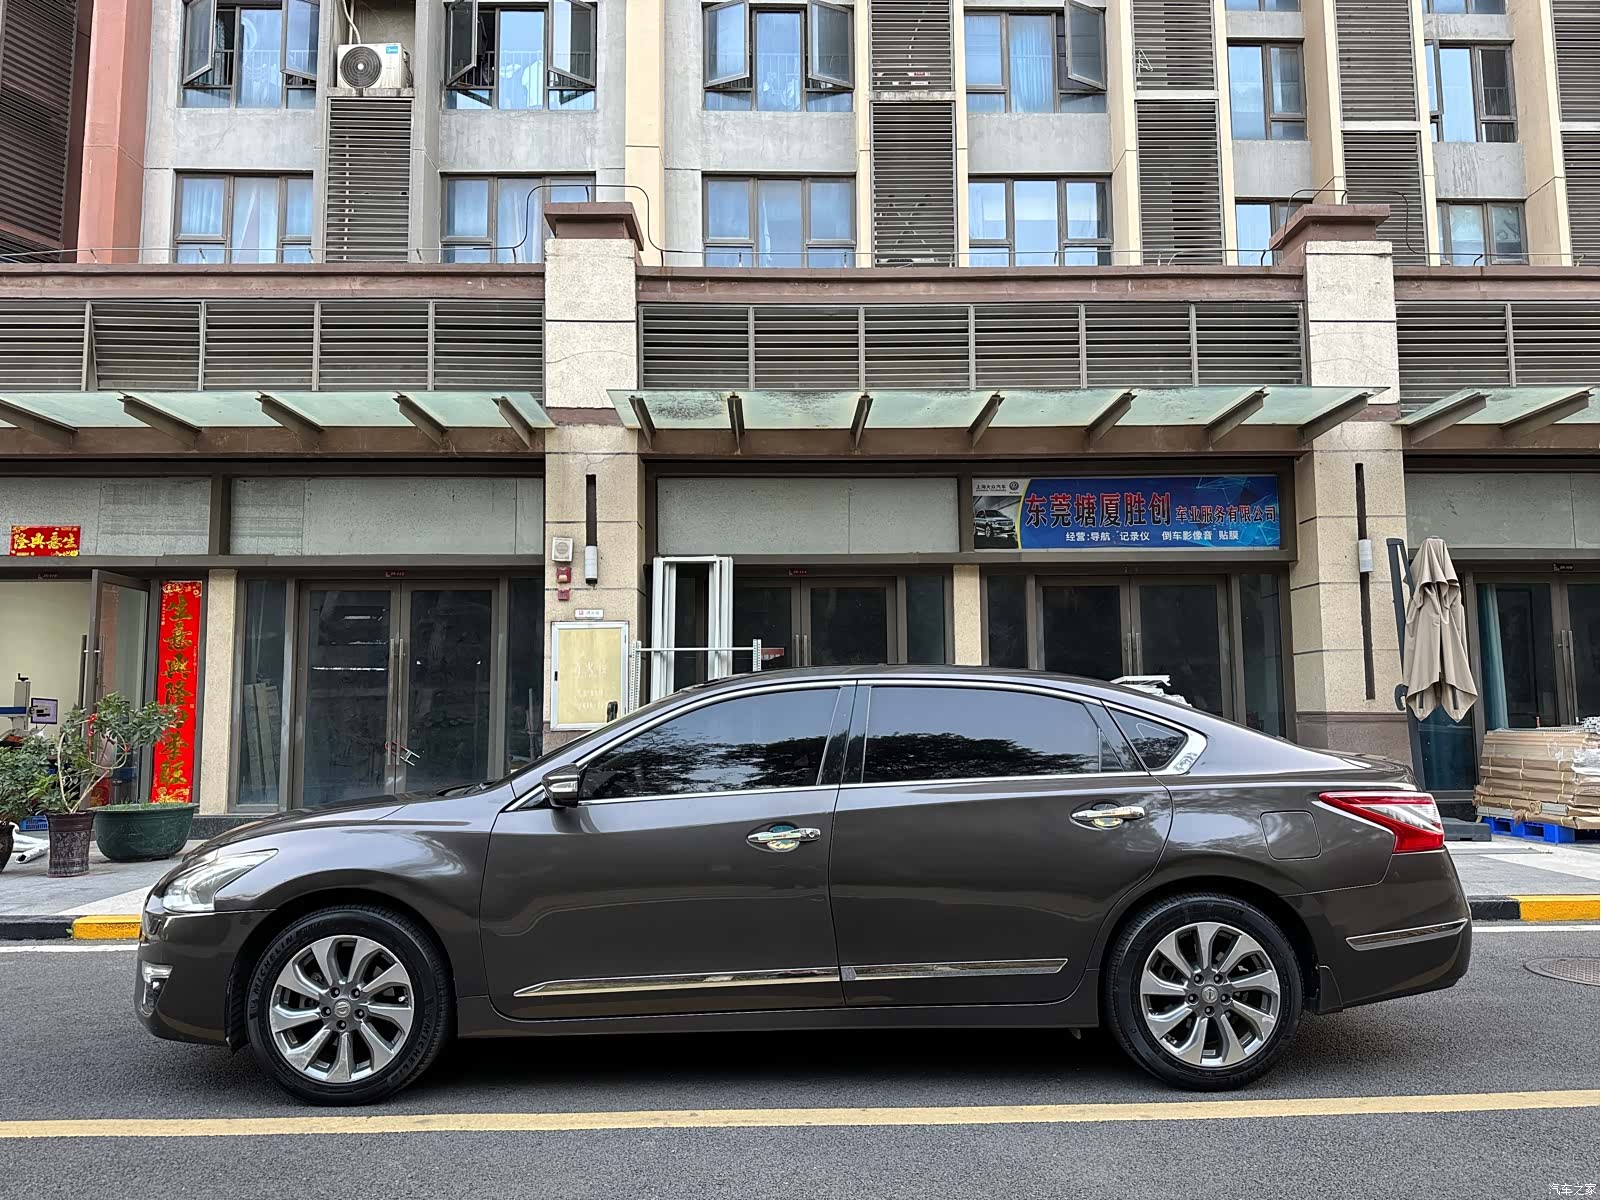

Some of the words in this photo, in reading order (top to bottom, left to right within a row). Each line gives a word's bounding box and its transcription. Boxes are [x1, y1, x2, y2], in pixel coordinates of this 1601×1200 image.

[1025, 492, 1172, 528] 东莞塘厦胜创
[1175, 504, 1277, 524] 车业服务有限公司
[1161, 530, 1213, 541] 倒车影像音
[1218, 530, 1239, 541] 贴膜
[253, 933, 296, 995] MICHELIN
